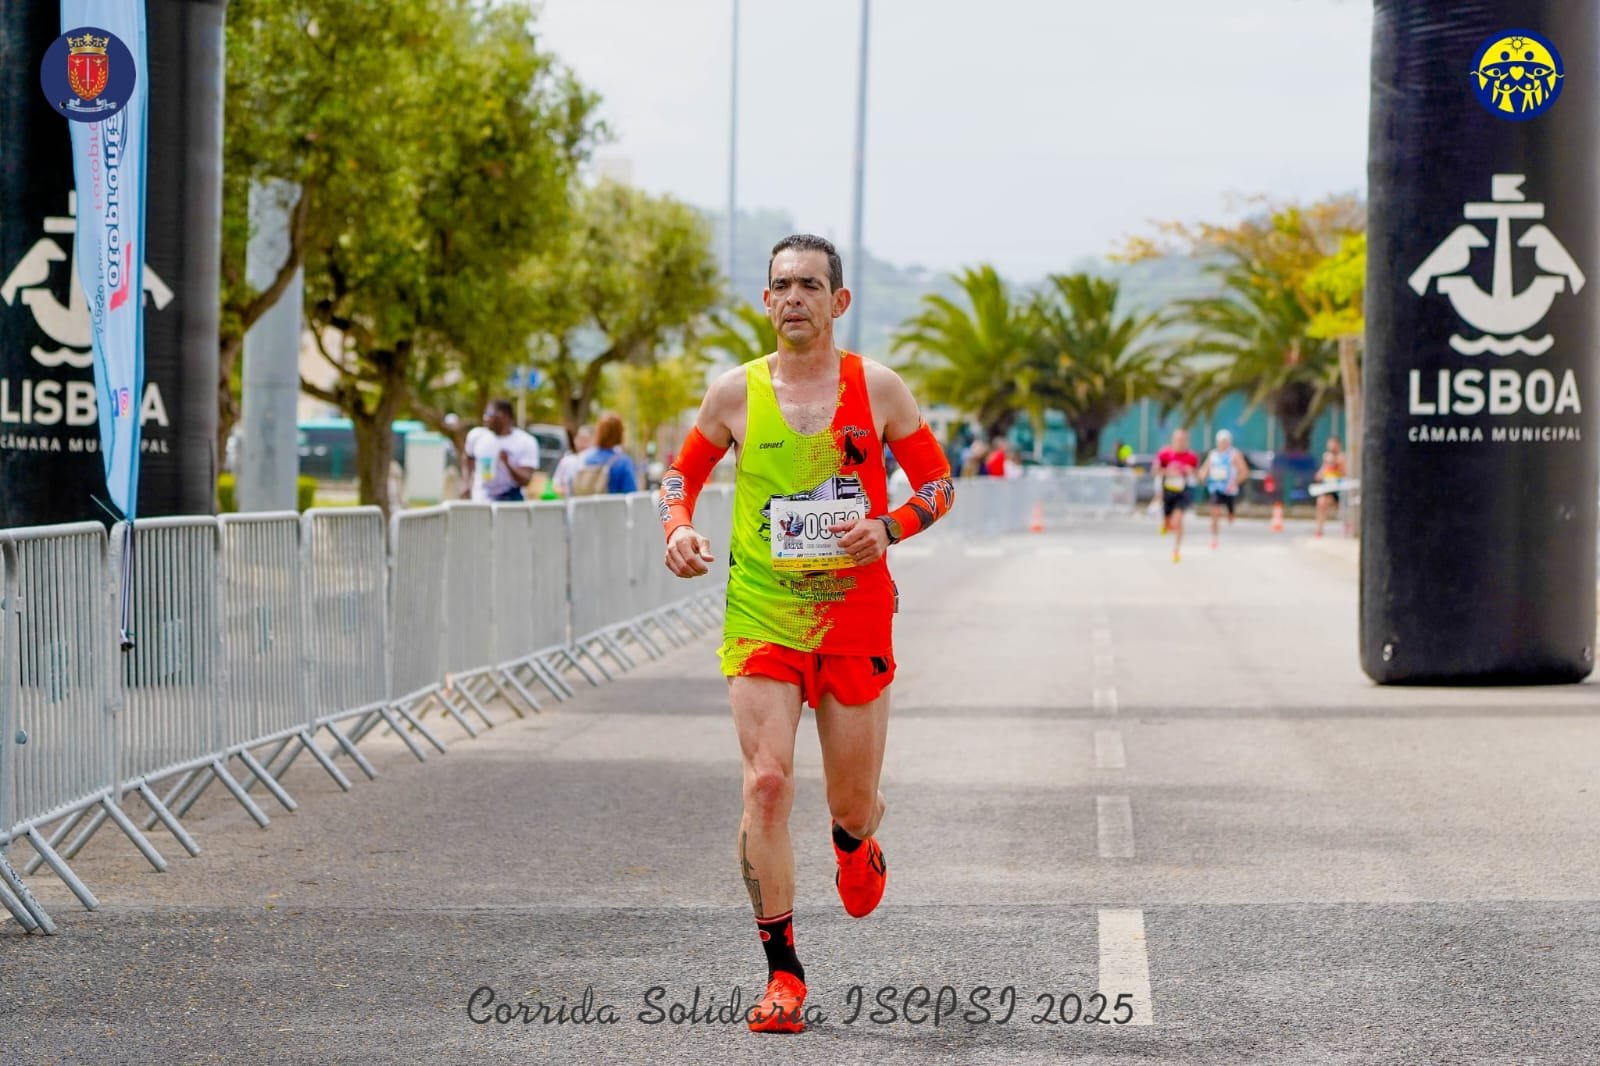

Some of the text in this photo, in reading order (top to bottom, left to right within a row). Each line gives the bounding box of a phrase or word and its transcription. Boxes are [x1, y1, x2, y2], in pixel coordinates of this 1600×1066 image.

[0, 378, 169, 427] LISBA
[1408, 368, 1582, 415] LISBOA
[0, 433, 169, 453] CÂMARA MUPAL
[1408, 424, 1582, 443] CÂMARA MUNICIPAL
